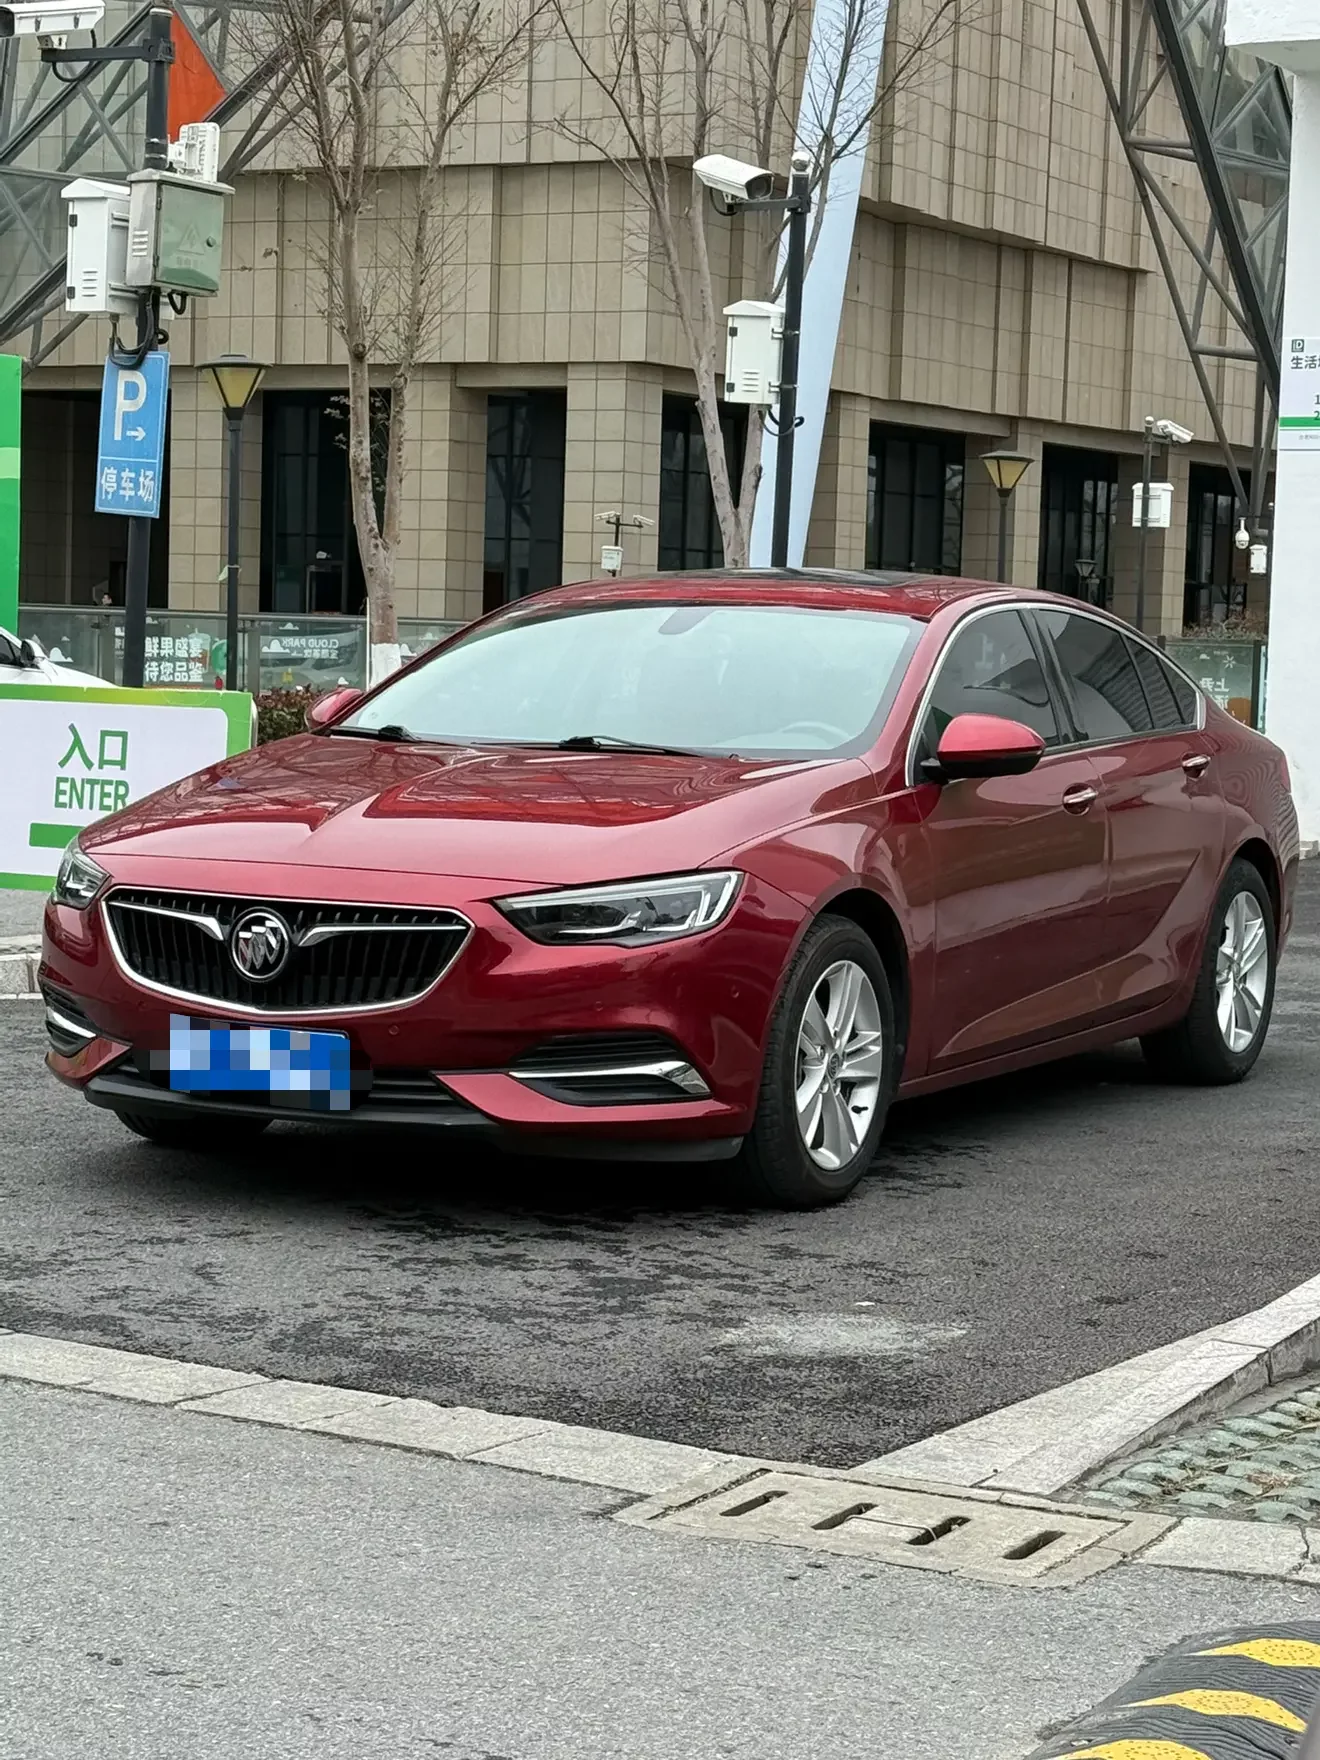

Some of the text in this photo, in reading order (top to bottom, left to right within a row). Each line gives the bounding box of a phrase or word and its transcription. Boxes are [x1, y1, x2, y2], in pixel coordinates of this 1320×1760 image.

[1291, 355, 1320, 369] 生活
[114, 369, 147, 441] P
[101, 466, 154, 503] 停车场
[144, 636, 203, 658] 鲜果盛宴
[144, 661, 203, 682] 待您品鉴
[58, 723, 128, 771] 入口
[54, 776, 130, 812] ENTER
